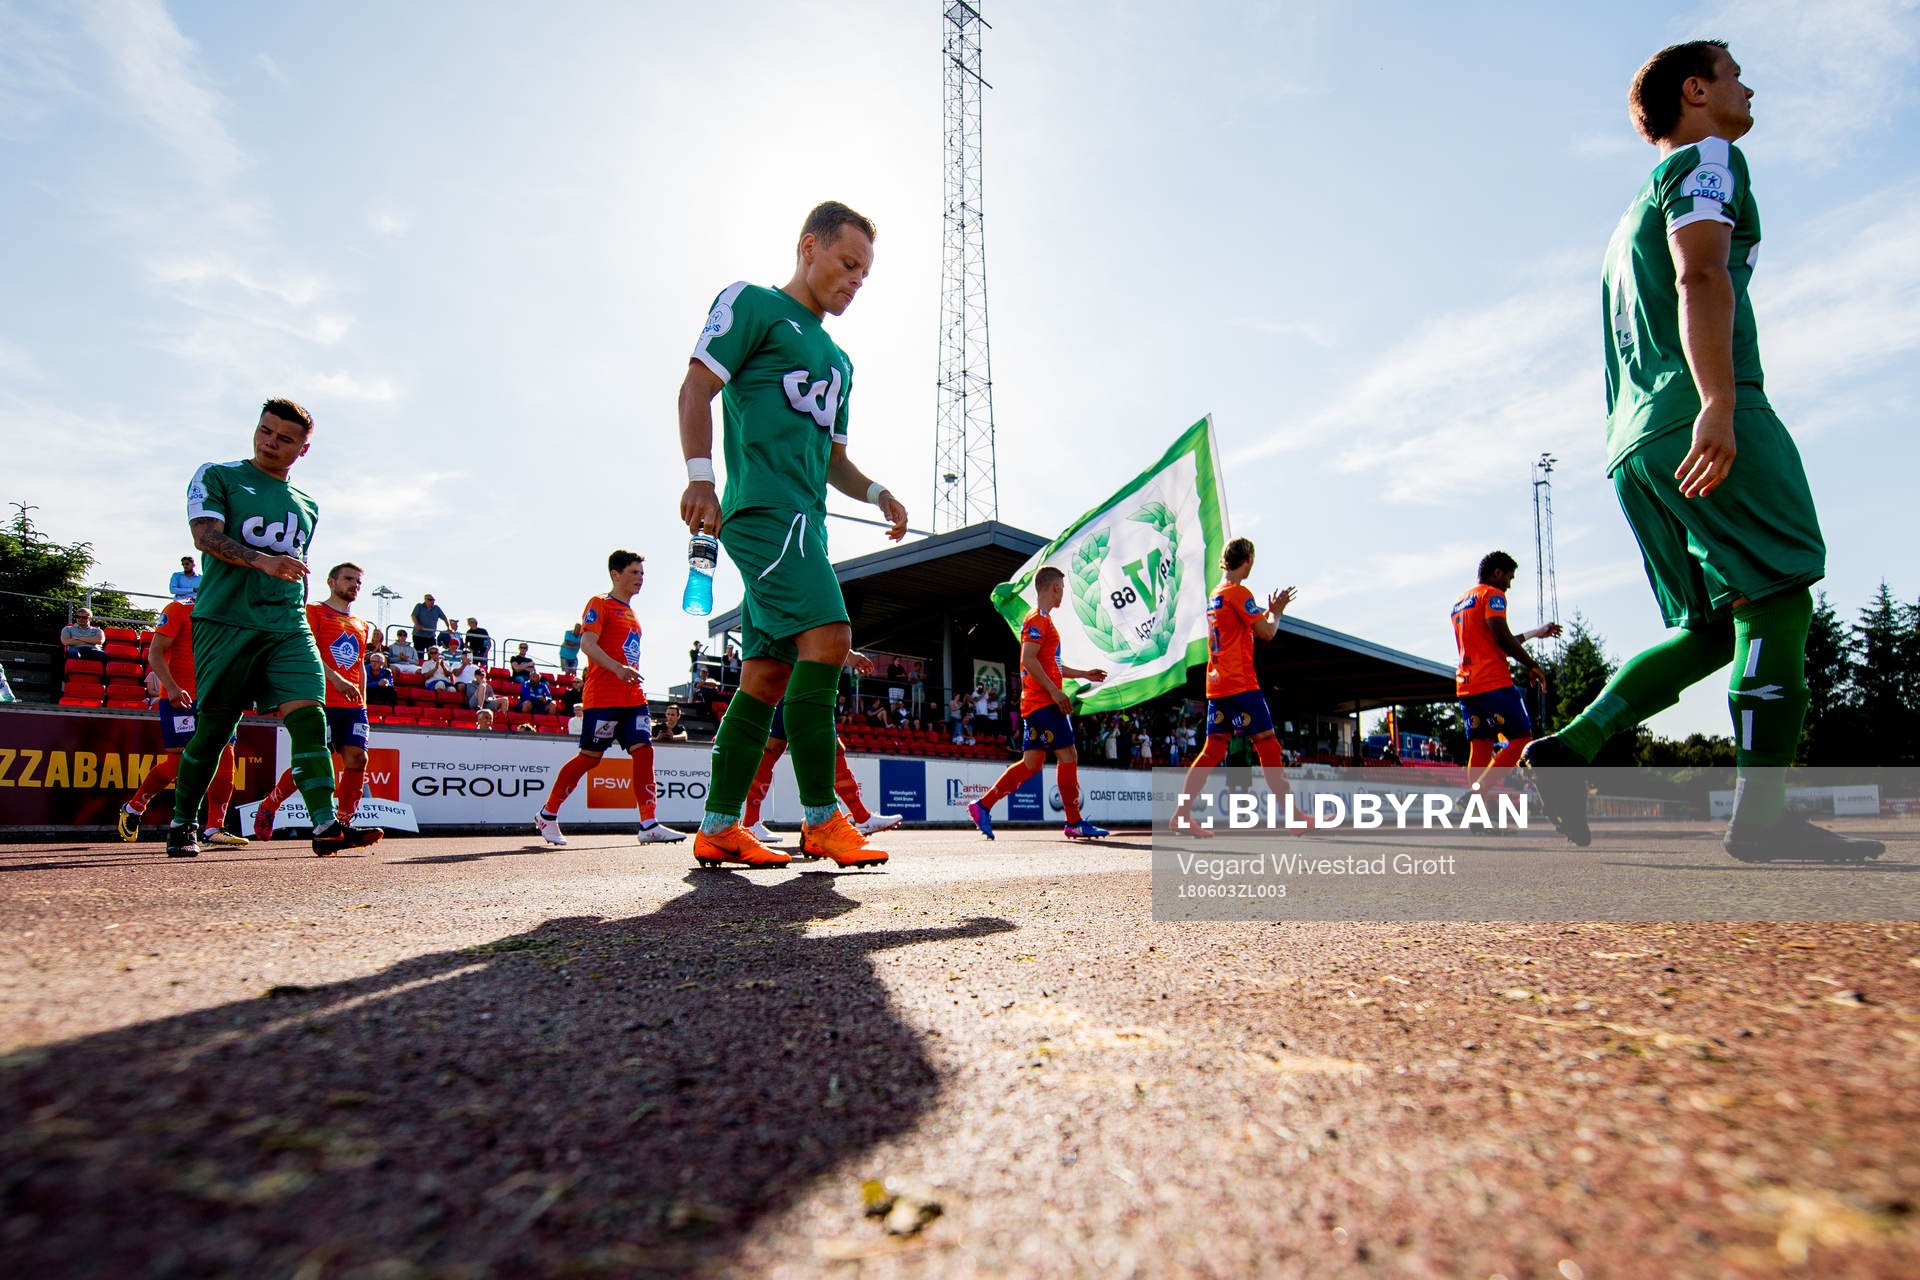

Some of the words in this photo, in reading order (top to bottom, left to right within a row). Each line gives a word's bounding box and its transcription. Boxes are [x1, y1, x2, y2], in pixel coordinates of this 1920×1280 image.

[1690, 189, 1726, 201] OBOS
[411, 762, 456, 771] PETRO
[458, 763, 517, 773] SUPPORT
[518, 764, 551, 774] WEST
[679, 770, 711, 778] SUPPO
[411, 776, 545, 798] GROUP
[593, 777, 631, 790] PSW
[1090, 790, 1117, 801] COAST
[1117, 791, 1146, 802] CENTER
[1147, 792, 1164, 802] BASE
[1165, 793, 1175, 802] AS
[364, 804, 407, 816] STENGT
